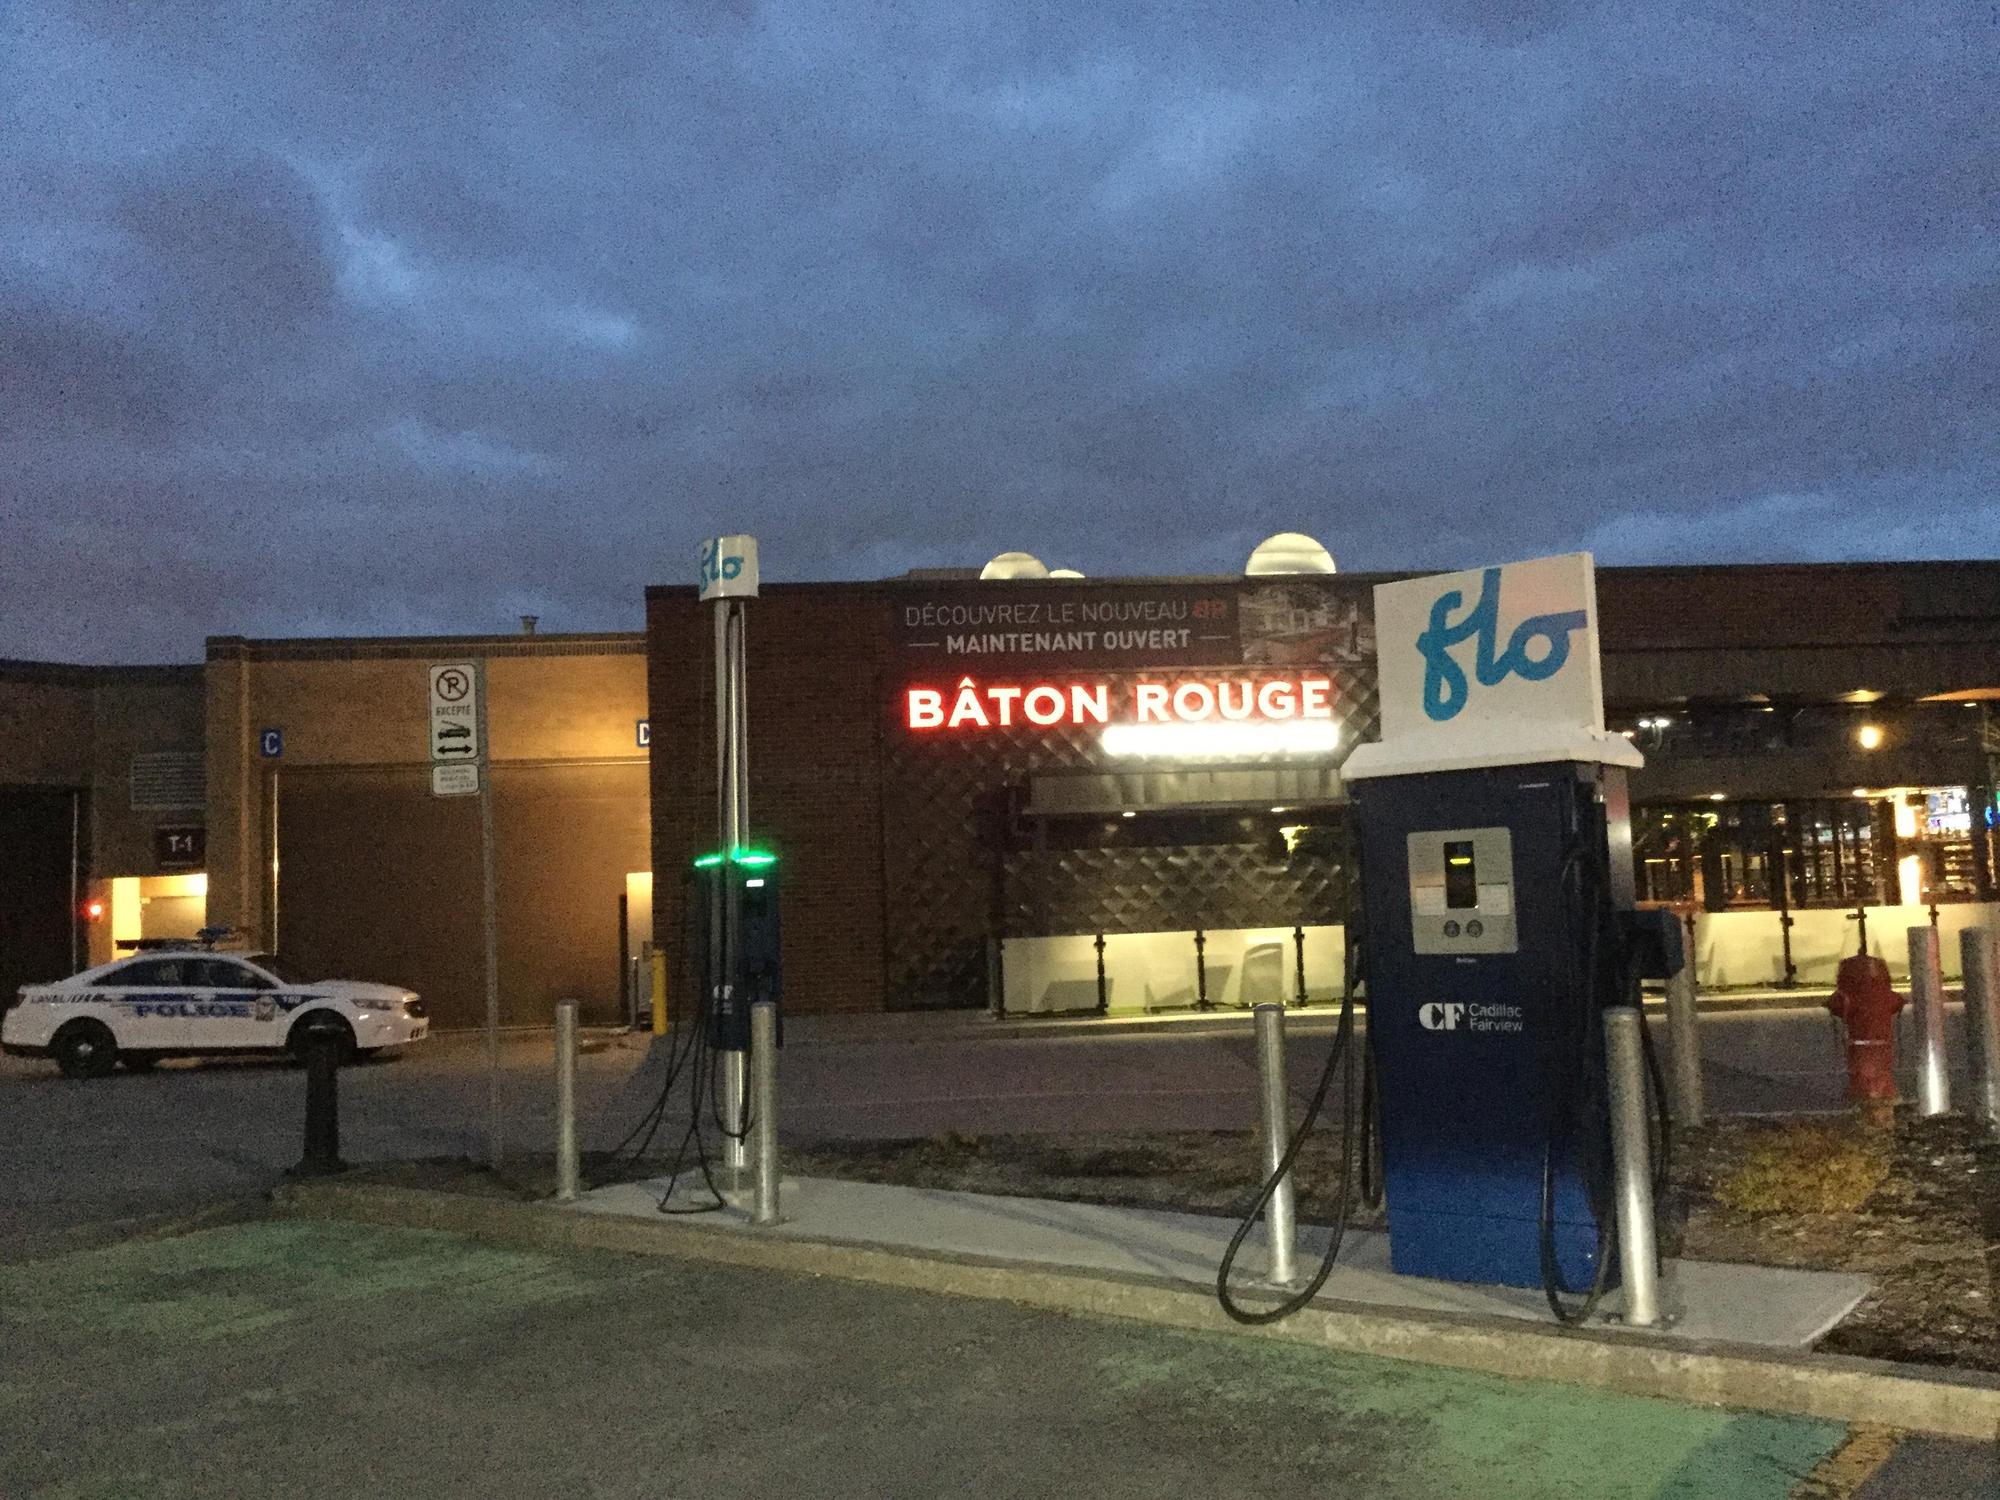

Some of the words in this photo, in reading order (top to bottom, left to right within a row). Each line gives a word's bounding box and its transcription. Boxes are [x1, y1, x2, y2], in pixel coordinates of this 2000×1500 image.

[905, 602, 1041, 627] DÉCOUVREZ
[1048, 603, 1074, 624] LE
[1082, 599, 1188, 622] NOUVEAU
[946, 631, 1098, 654] MAINTENANT
[1103, 628, 1191, 650] OUVERT
[1416, 567, 1588, 722] flo
[908, 676, 1109, 729] BÂTON
[1136, 680, 1332, 722] ROUGE
[264, 732, 278, 755] C
[168, 835, 193, 852] T-1
[136, 1003, 250, 1018] POLICE
[1419, 1002, 1465, 1030] CF
[1468, 1003, 1522, 1018] Cadillac
[1470, 1018, 1523, 1031] Fairview
